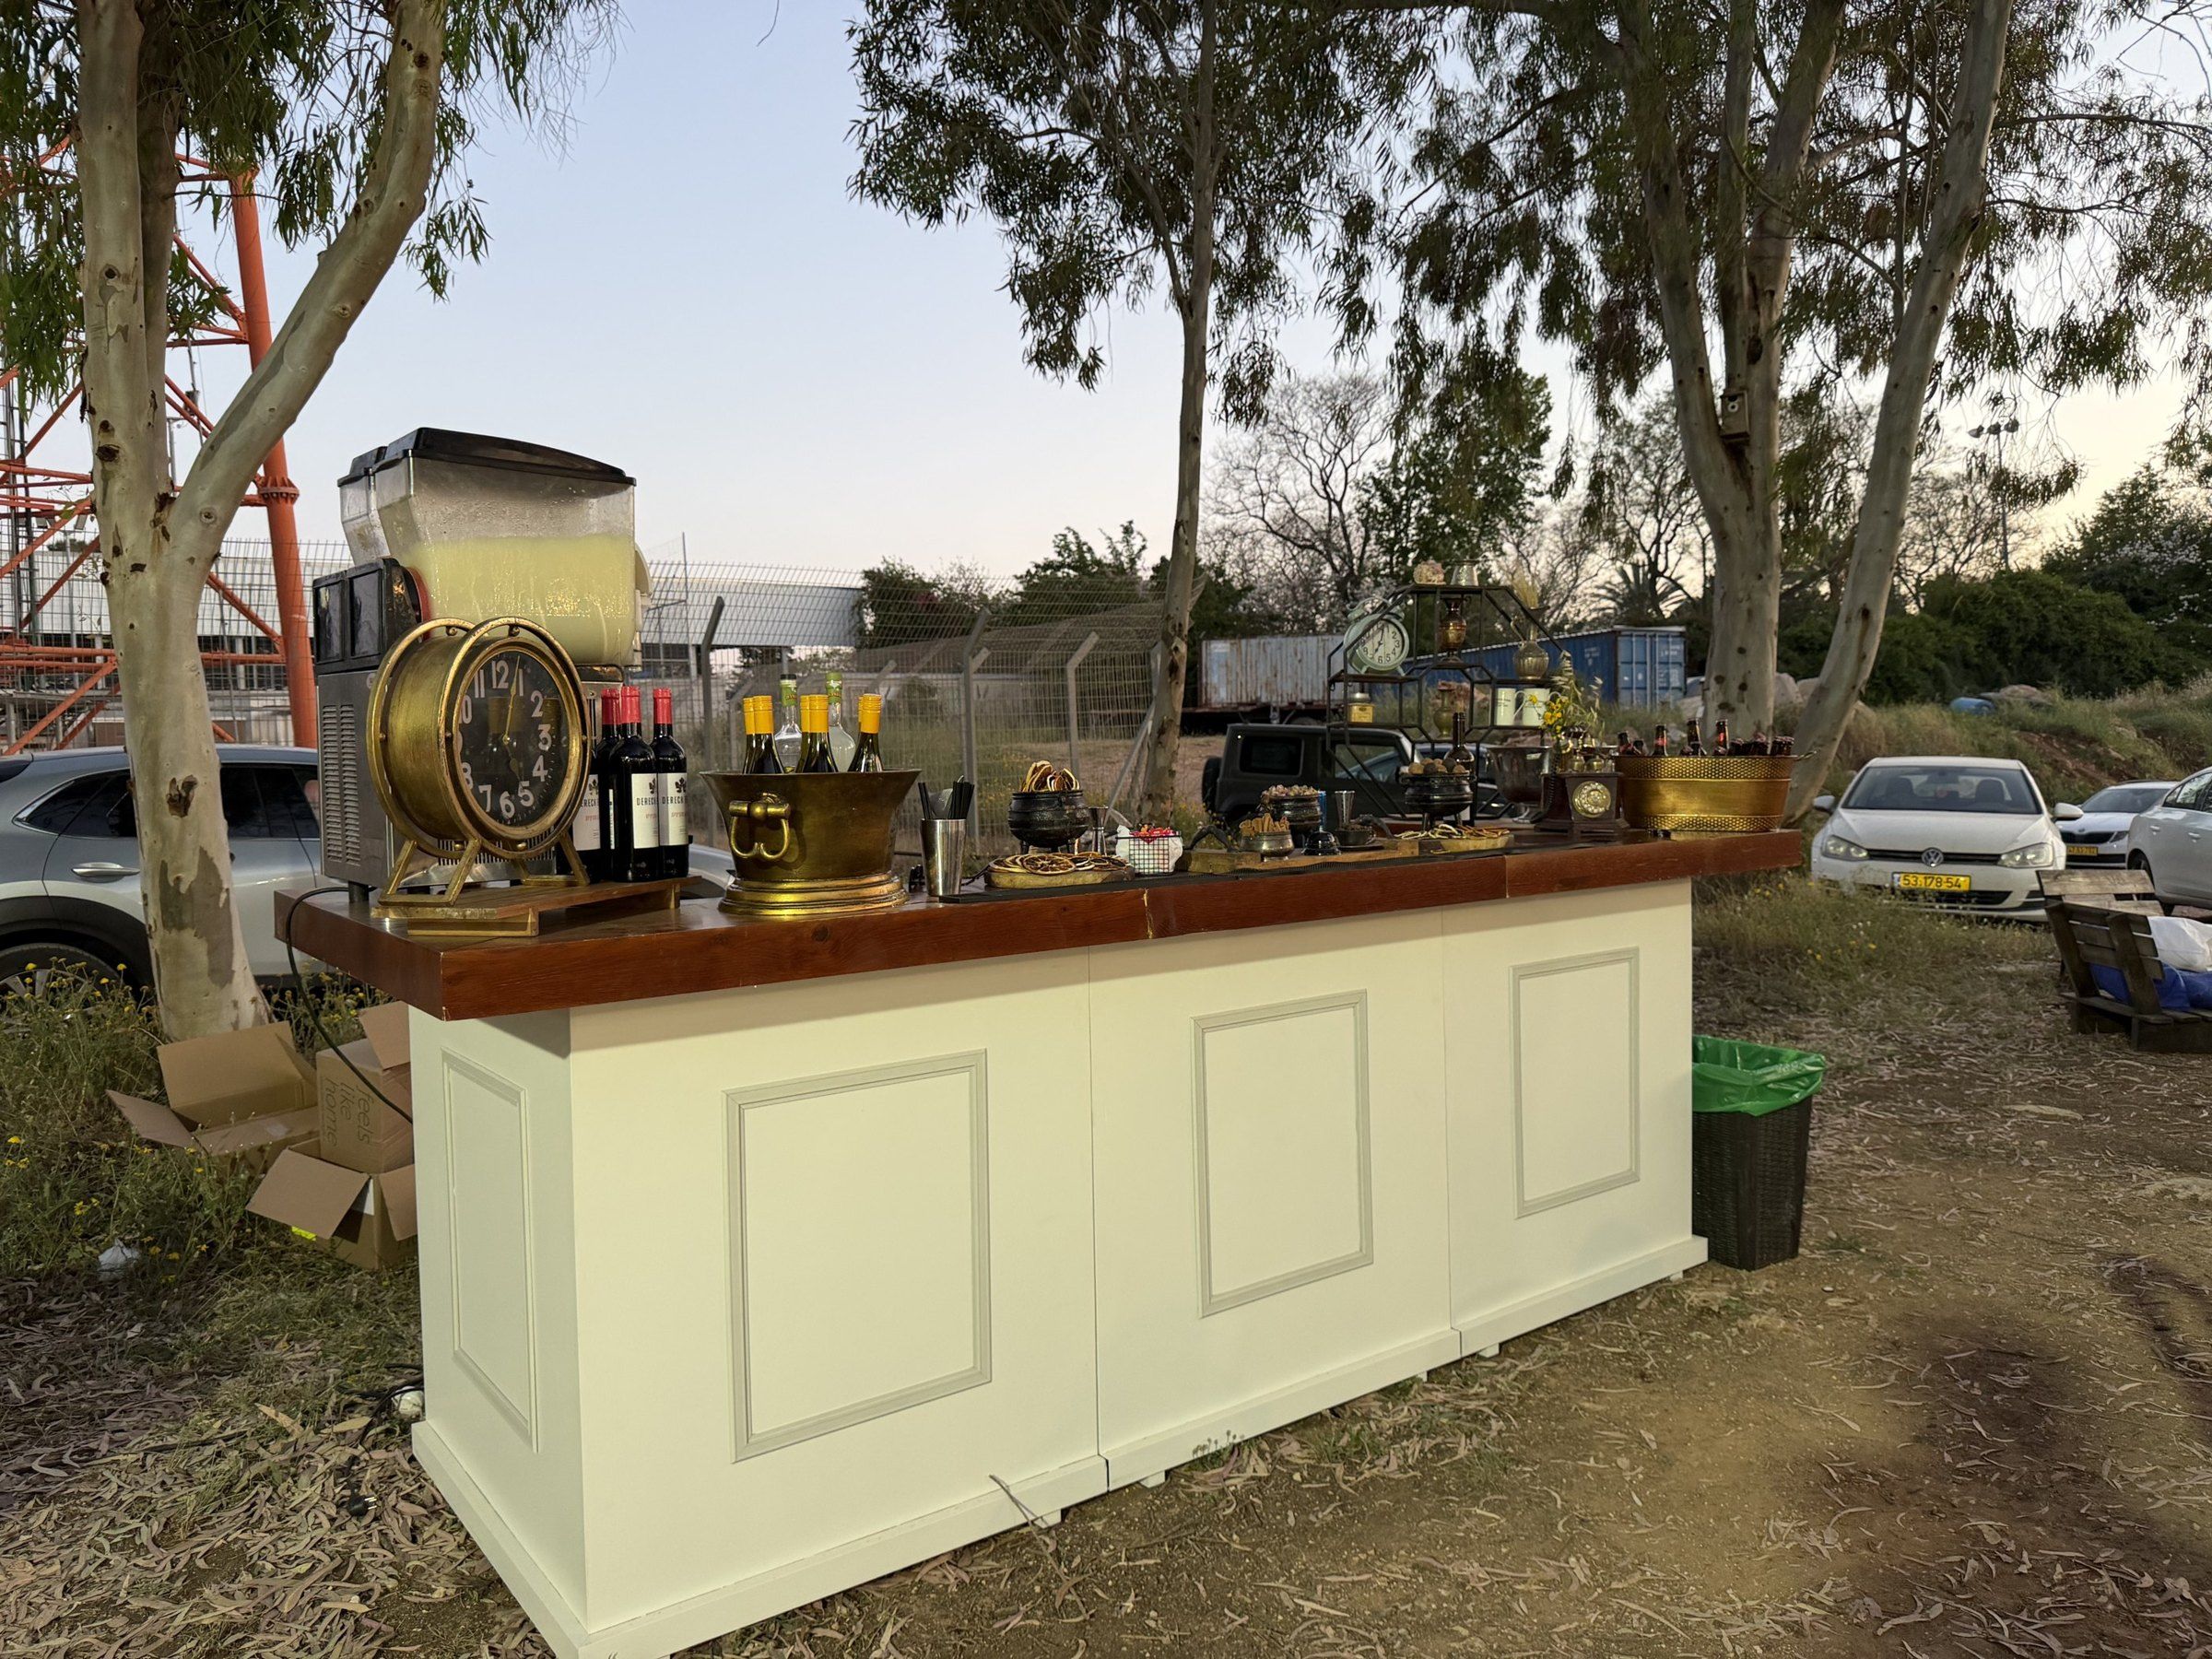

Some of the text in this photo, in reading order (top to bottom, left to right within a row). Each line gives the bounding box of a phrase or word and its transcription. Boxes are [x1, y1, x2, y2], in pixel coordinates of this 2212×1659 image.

[1392, 630, 1397, 640] 2
[1394, 640, 1400, 648] 3
[490, 659, 510, 689] 12
[1377, 655, 1383, 664] 6
[474, 669, 486, 699] 11
[518, 668, 524, 697] 1
[459, 695, 473, 724] 0
[530, 689, 544, 718] 2
[537, 724, 552, 751] 3
[462, 762, 474, 790] 8
[532, 755, 548, 782] 4
[478, 784, 492, 813] 7
[499, 791, 515, 819] 6
[517, 781, 535, 807] 5
[324, 1077, 340, 1147] home
[340, 1082, 355, 1121] like
[357, 1085, 374, 1145] feels
